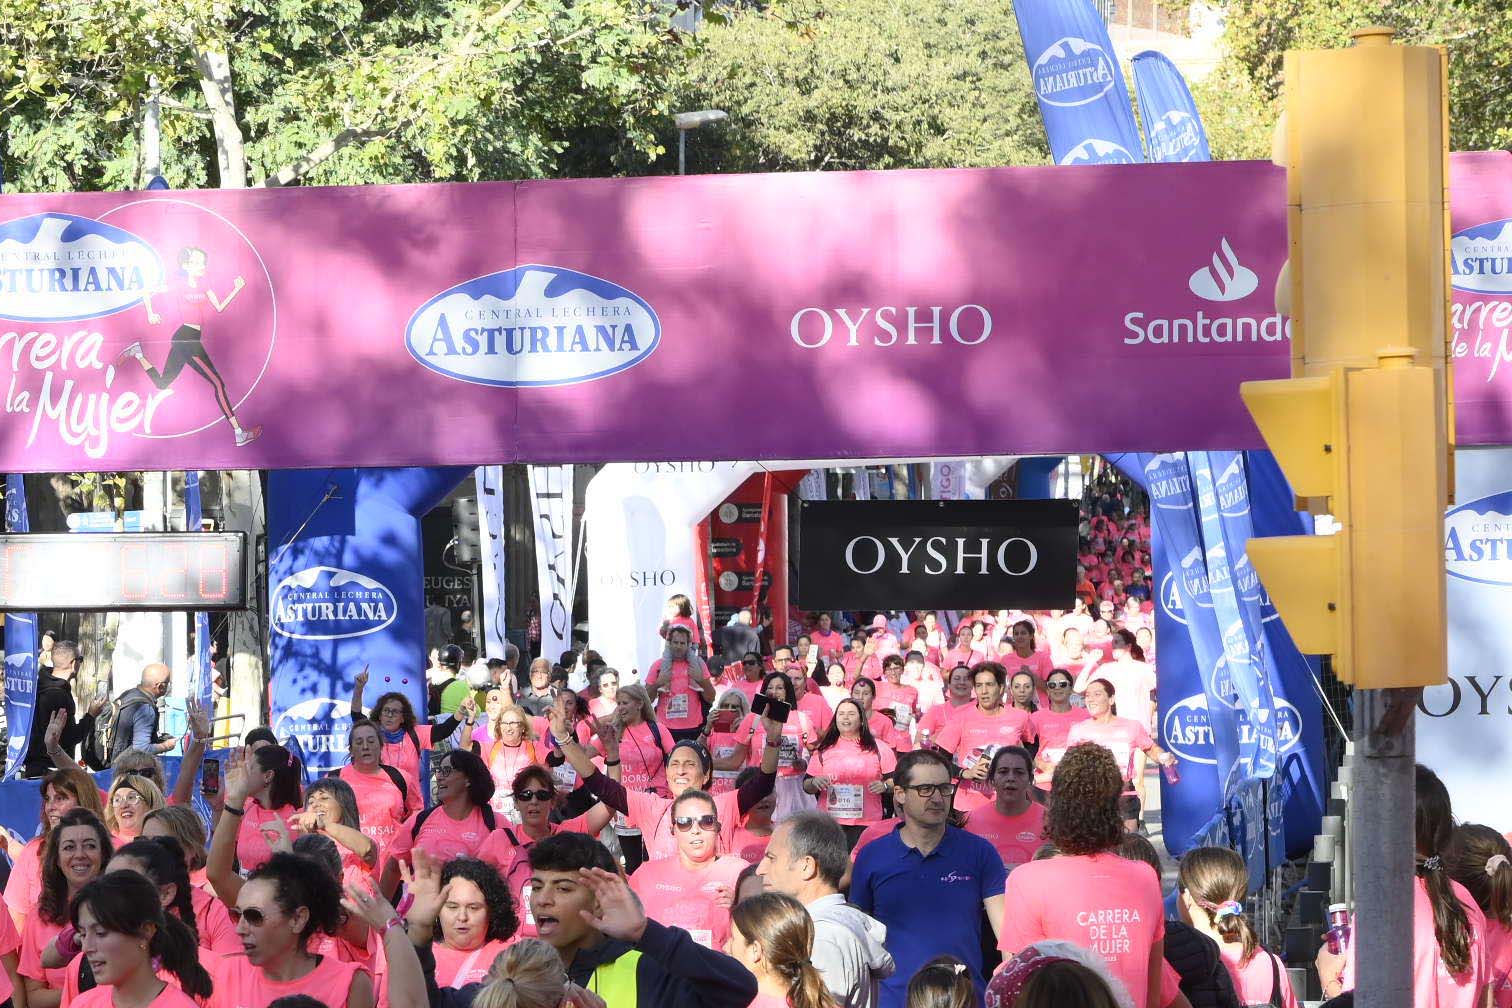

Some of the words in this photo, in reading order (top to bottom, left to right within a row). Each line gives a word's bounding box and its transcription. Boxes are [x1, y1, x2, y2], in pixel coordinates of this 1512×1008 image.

[465, 308, 543, 320] CENTRAL
[552, 306, 632, 319] LECHERA
[425, 312, 641, 356] ASTURIANA
[790, 304, 993, 348] OYSHO
[1123, 311, 1292, 346] Santand
[6, 374, 31, 413] la
[25, 363, 175, 459] Mujer
[845, 536, 1037, 575] OYSHO
[289, 592, 330, 600] CENTRAL
[335, 591, 383, 599] LECHERA
[276, 597, 387, 622] ASTURIANA
[360, 826, 394, 836] ORSAL
[1077, 908, 1140, 927] CARRERA
[1089, 926, 1107, 940] DE
[1112, 925, 1128, 939] LA
[1089, 939, 1131, 954] MUJER
